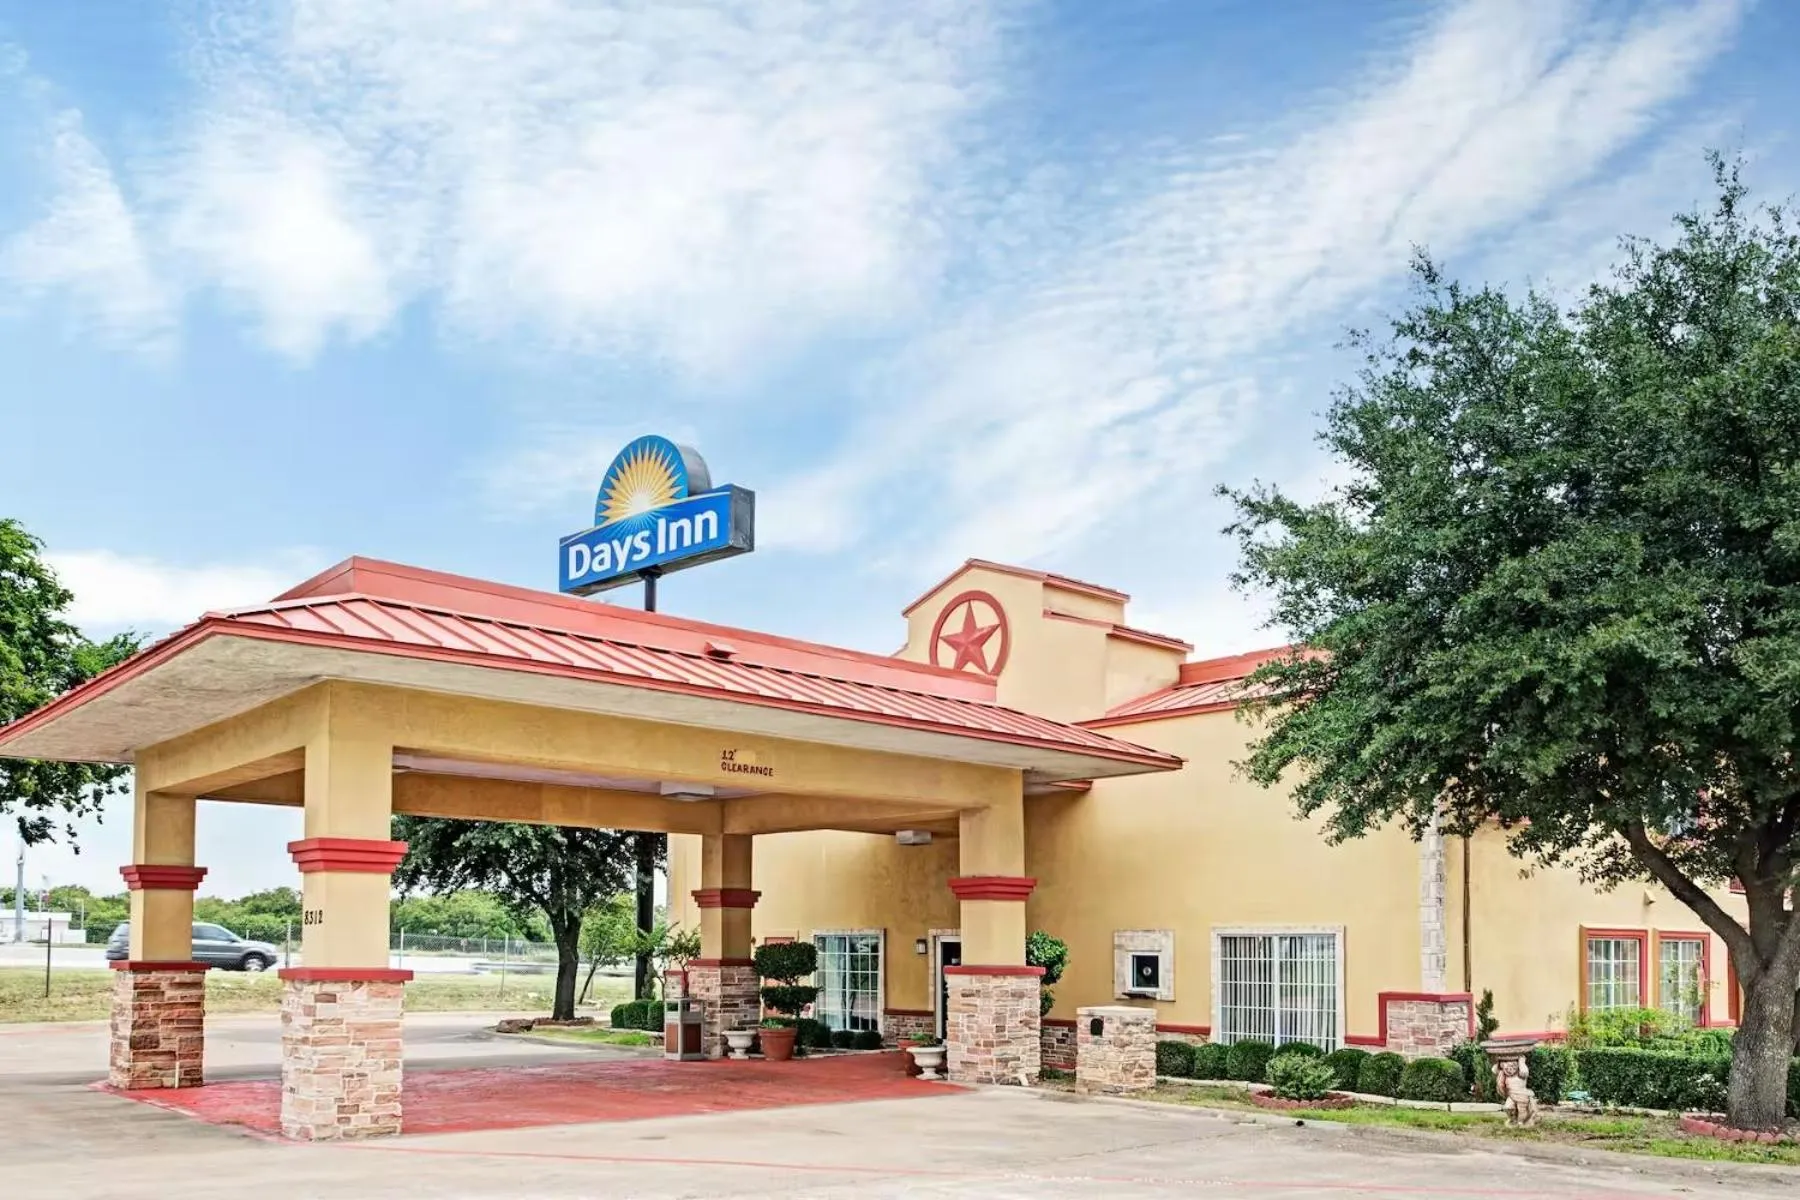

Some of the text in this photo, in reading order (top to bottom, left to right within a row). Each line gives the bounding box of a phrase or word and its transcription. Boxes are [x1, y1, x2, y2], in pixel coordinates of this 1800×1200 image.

[568, 509, 718, 580] Days Inn
[721, 761, 774, 776] CLEARANCE
[304, 910, 323, 925] 8312
